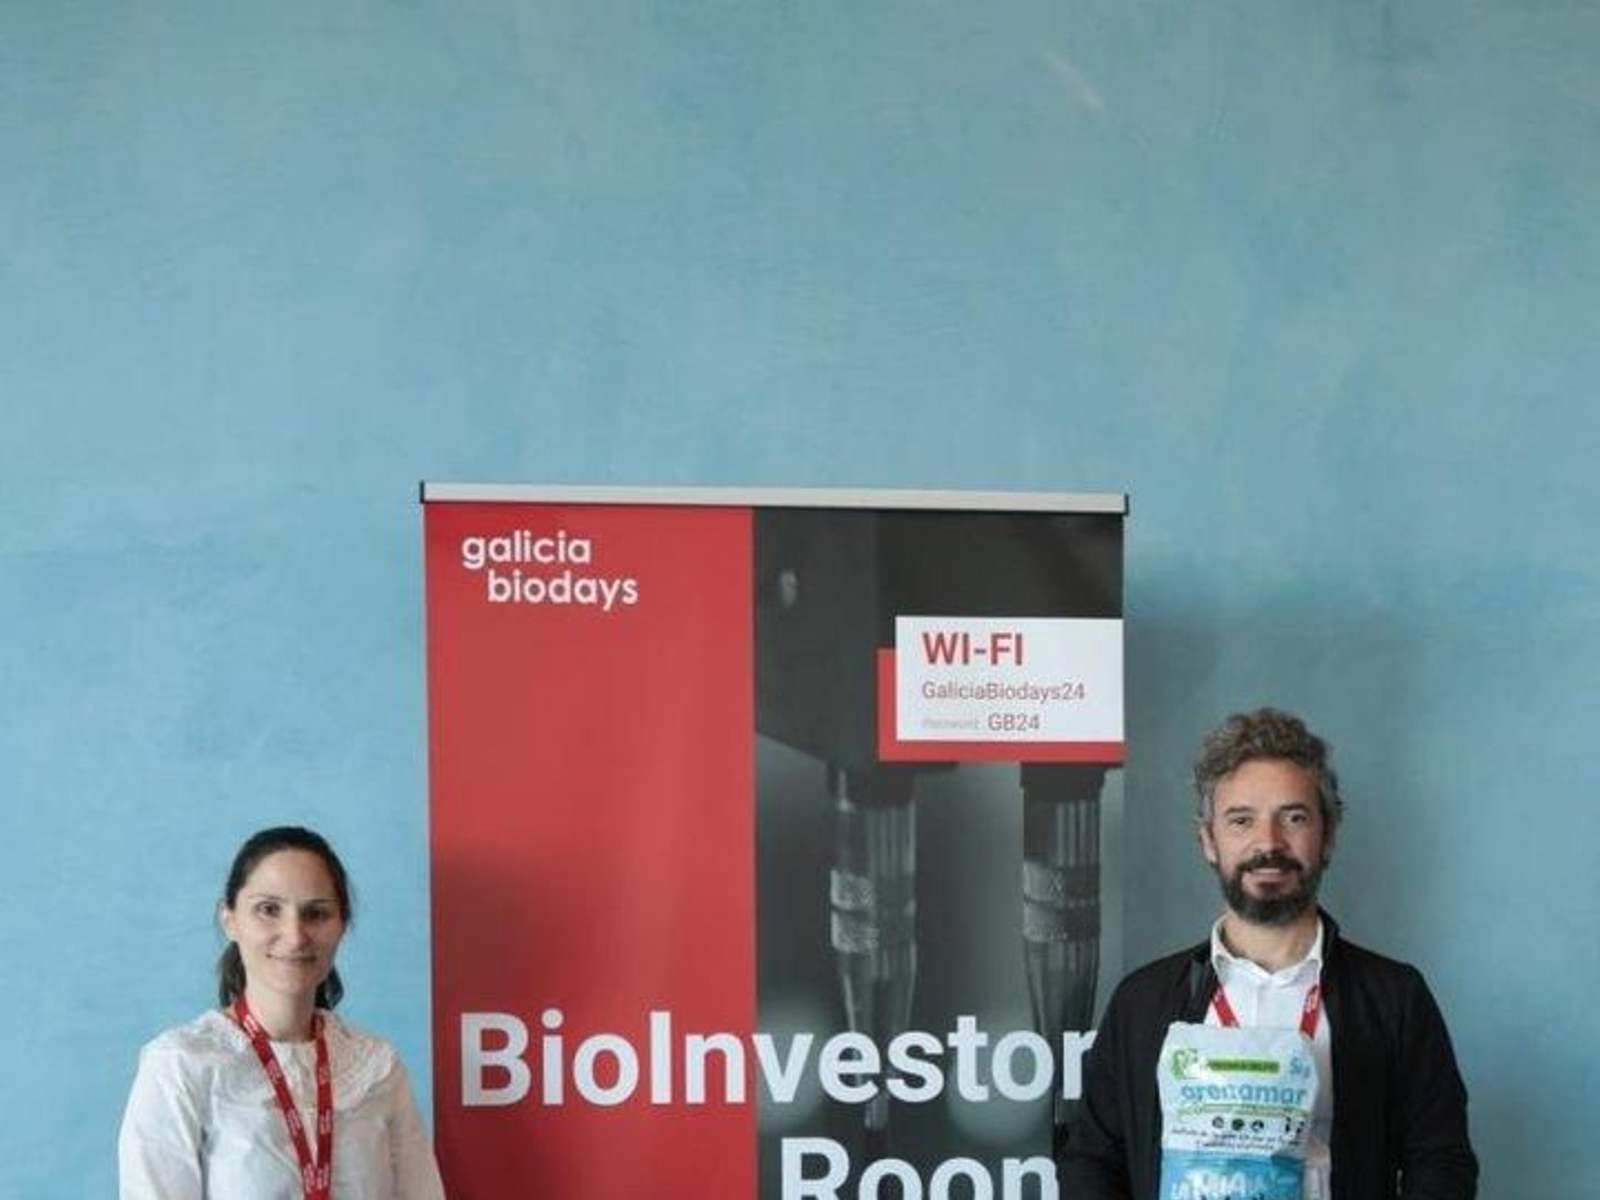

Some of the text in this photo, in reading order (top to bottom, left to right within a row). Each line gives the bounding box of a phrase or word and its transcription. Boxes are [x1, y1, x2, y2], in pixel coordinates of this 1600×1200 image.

[462, 530, 591, 569] galicia
[487, 569, 639, 611] biodays
[922, 632, 1023, 666] WI-FI
[921, 681, 1085, 704] GaliciaBiodays24
[987, 713, 1041, 731] GB24
[460, 1010, 1098, 1106] BioInvestor
